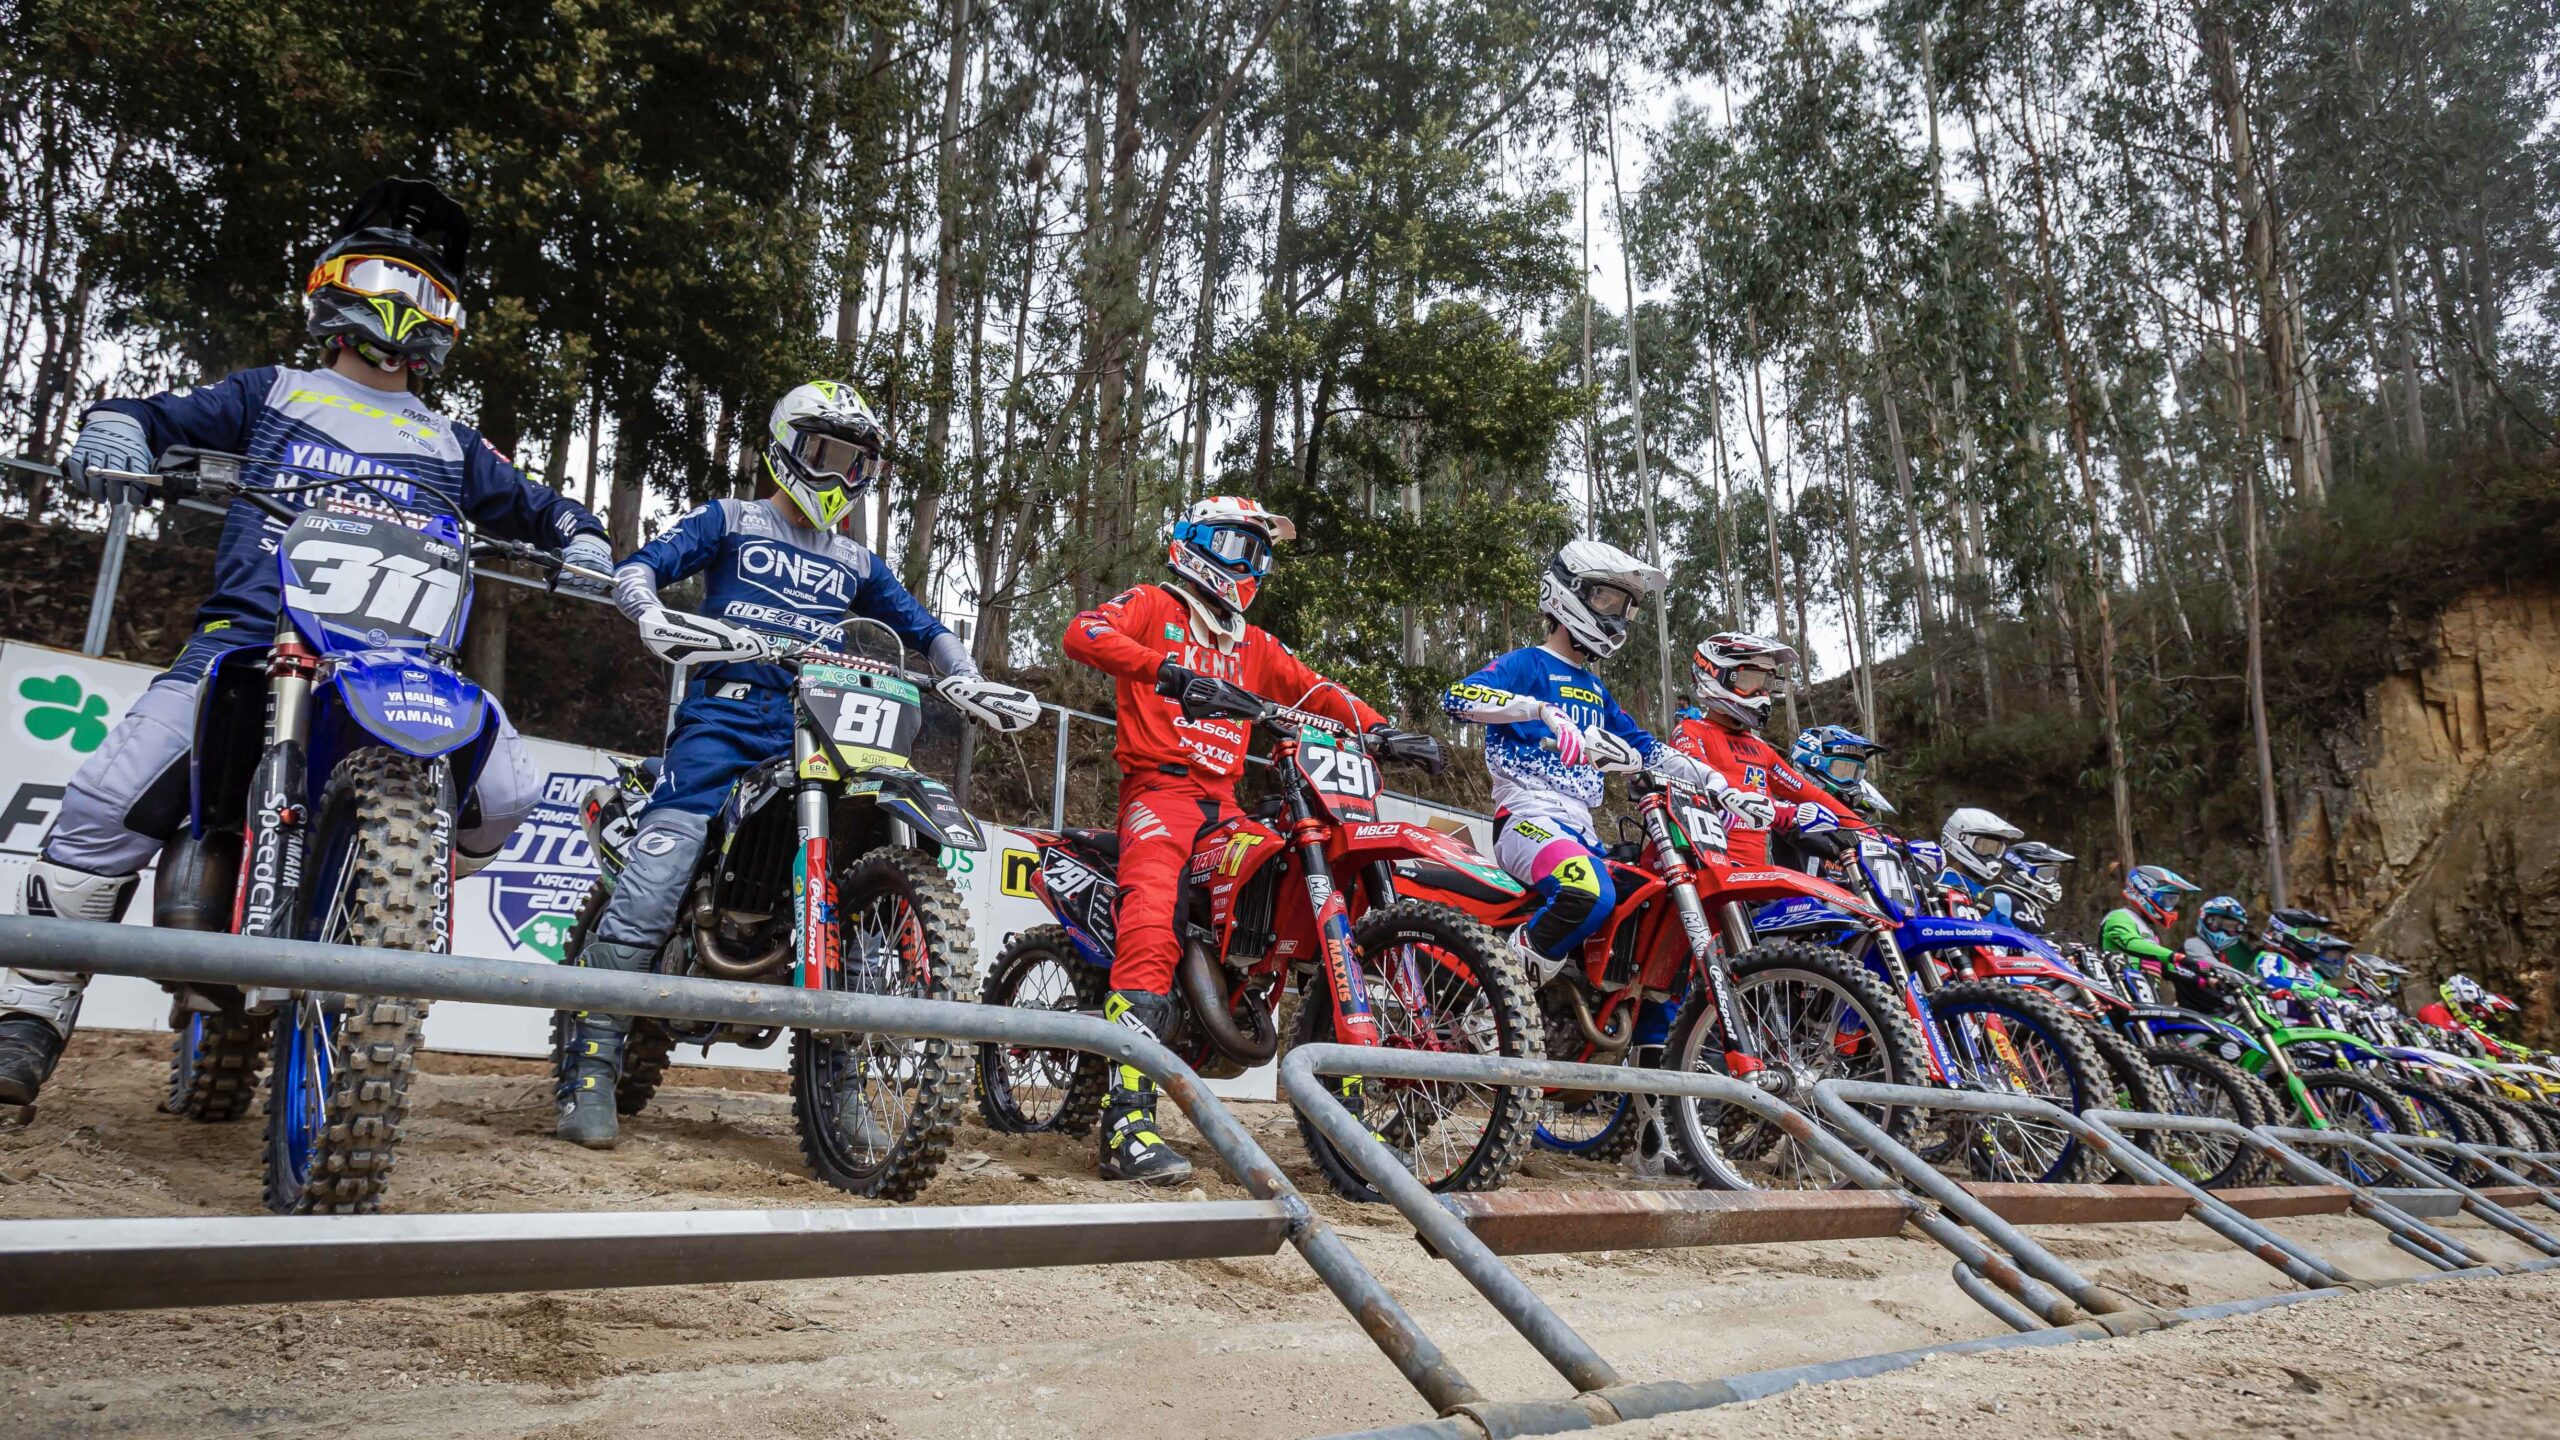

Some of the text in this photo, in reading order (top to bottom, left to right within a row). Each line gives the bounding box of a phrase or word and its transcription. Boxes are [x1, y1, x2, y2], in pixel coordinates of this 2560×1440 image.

[291, 444, 410, 501] YAMAHA
[284, 539, 463, 638] 311
[383, 709, 455, 730] YAMAHA
[832, 691, 902, 750] 81
[1172, 715, 1242, 746] GASGAS
[1275, 706, 1345, 735] RENTHAL
[1307, 746, 1376, 800] 291
[1771, 763, 1804, 790] YAMAHA
[281, 828, 305, 888] YAMAHA
[1326, 938, 1352, 1003] MAXXIS
[1709, 964, 1738, 1041] Polisport
